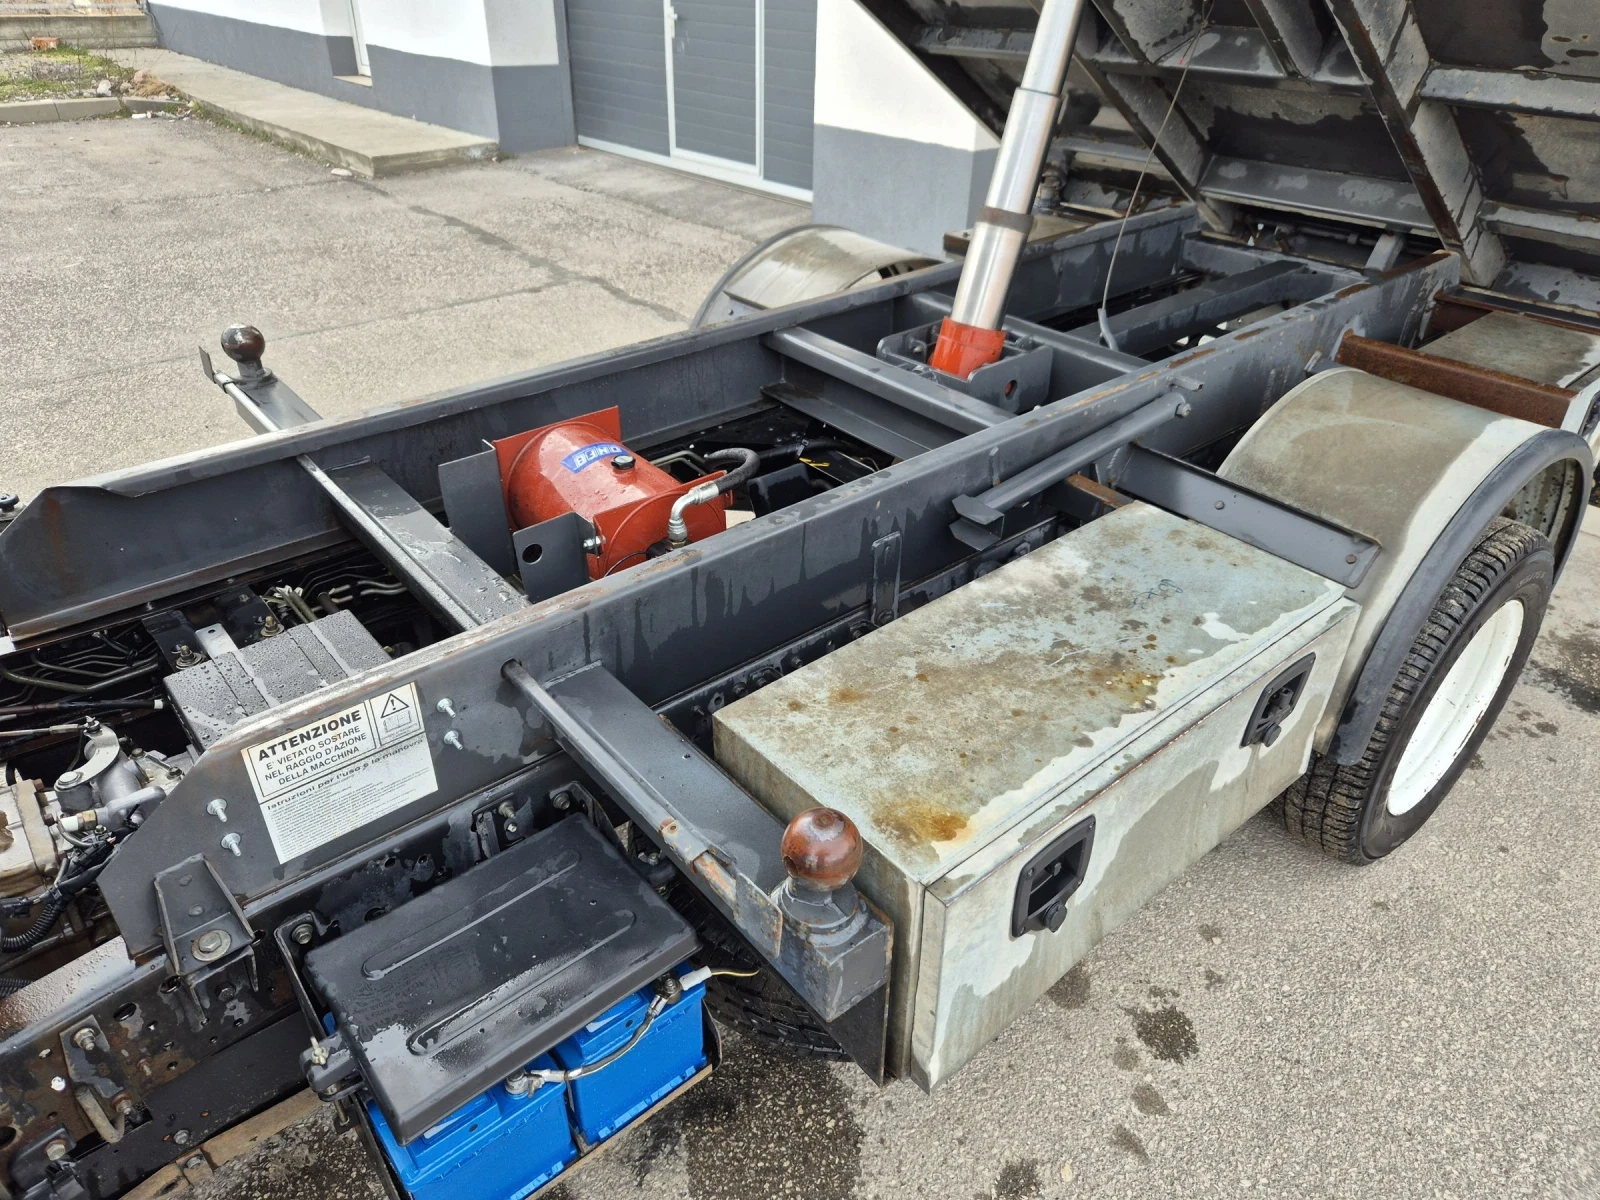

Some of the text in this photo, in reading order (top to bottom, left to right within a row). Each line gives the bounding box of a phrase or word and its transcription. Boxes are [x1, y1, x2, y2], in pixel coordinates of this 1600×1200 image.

[258, 709, 362, 762] ATTENZIONE
[264, 769, 285, 781] NEL
[285, 751, 323, 773] RAGGIO
[324, 732, 367, 756] D'AZIONE
[276, 744, 316, 765] VIETATO
[317, 725, 361, 749] SOSTARE
[267, 785, 315, 811] Istruzioni
[317, 777, 334, 790] per
[336, 766, 361, 780] l'uso
[371, 755, 382, 765] la
[380, 737, 423, 760] manovra
[278, 745, 360, 786] DELLA MACCHINA
